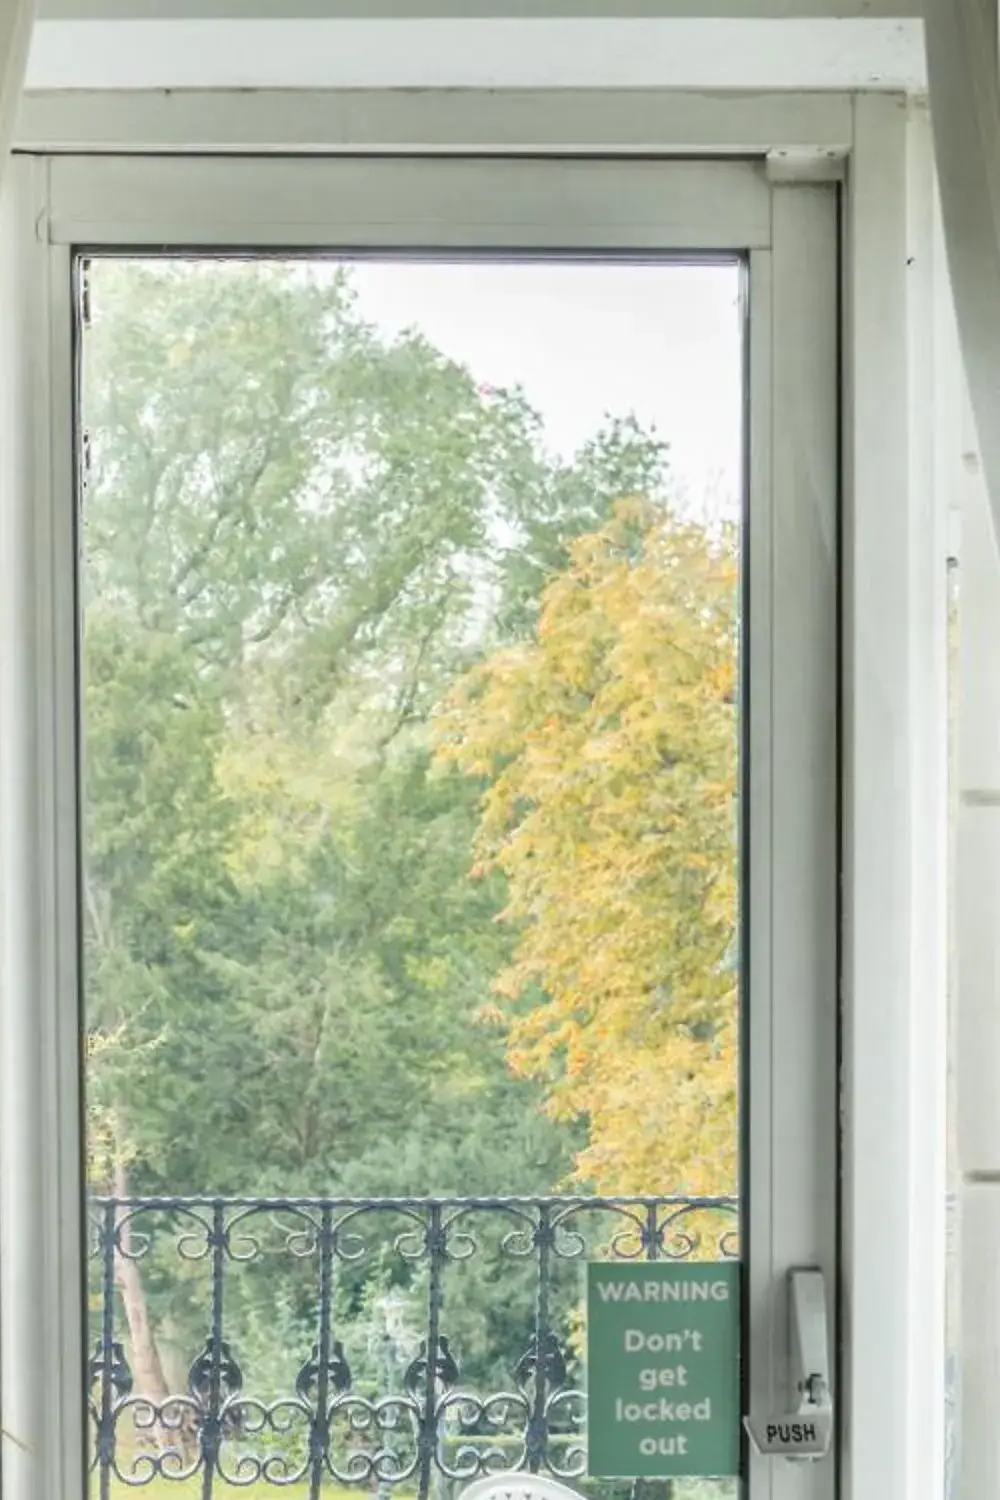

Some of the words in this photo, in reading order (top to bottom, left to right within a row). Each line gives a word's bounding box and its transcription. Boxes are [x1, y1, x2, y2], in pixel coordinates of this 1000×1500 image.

[597, 1281, 729, 1302] WARNING
[624, 1329, 703, 1352] Don't
[639, 1365, 688, 1391] get
[615, 1397, 711, 1421] locked
[766, 1423, 816, 1443] PUSH
[639, 1435, 688, 1455] out
